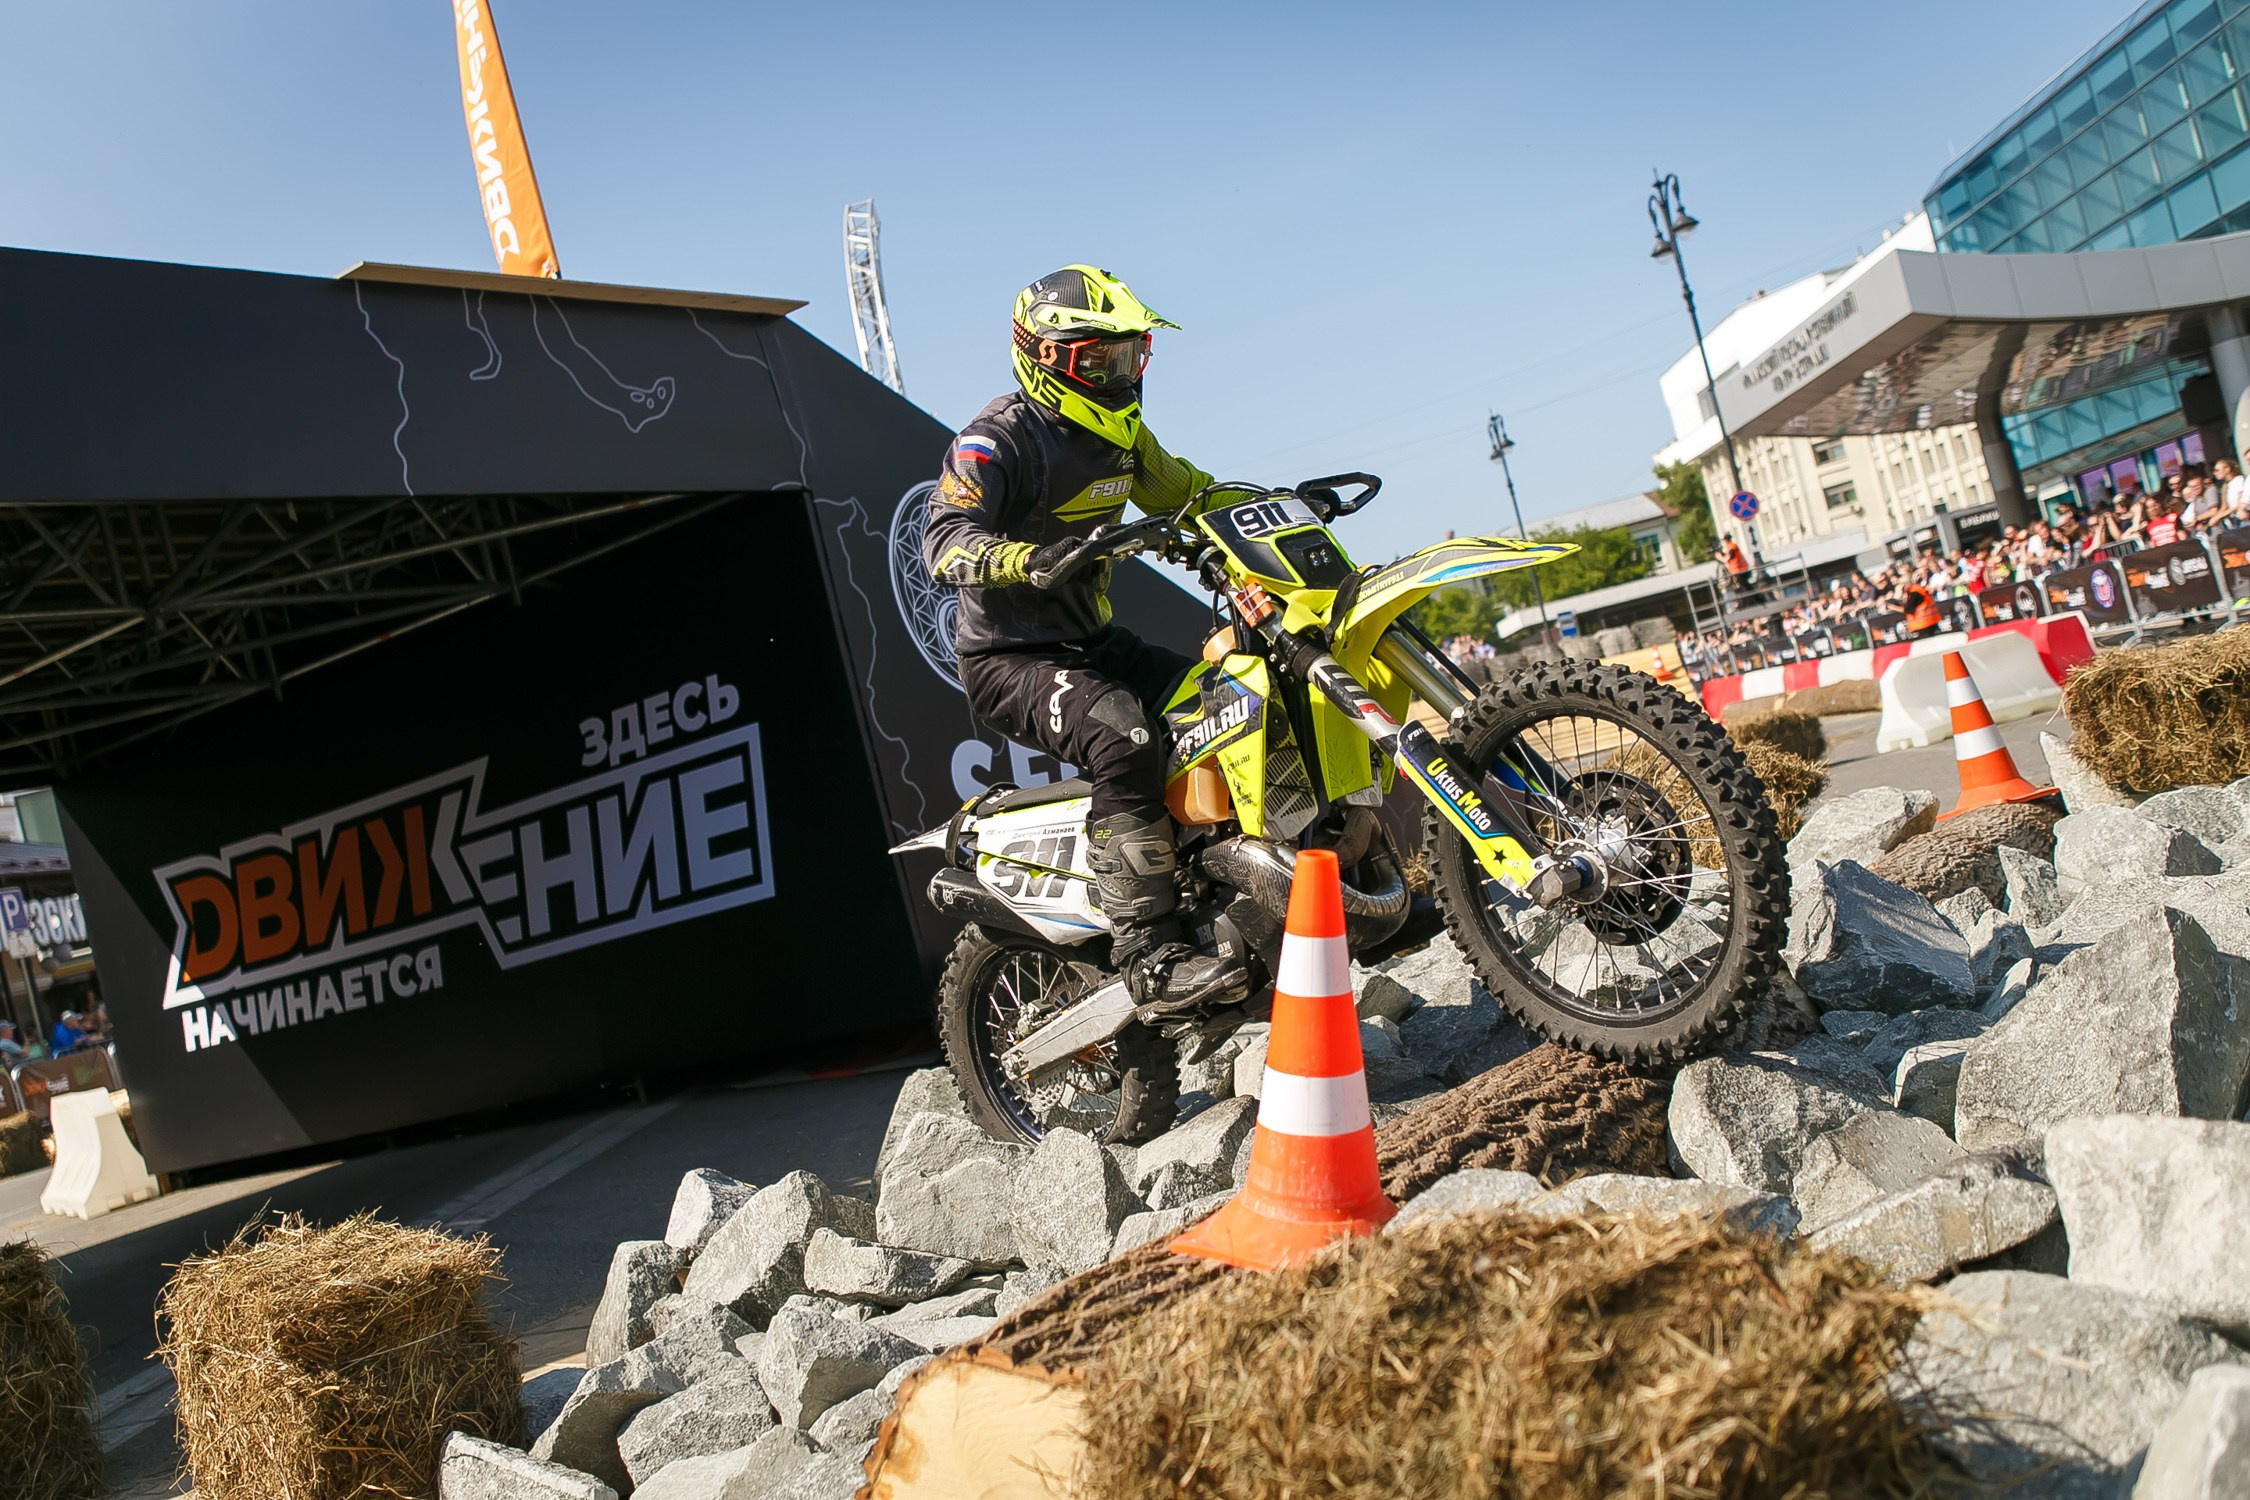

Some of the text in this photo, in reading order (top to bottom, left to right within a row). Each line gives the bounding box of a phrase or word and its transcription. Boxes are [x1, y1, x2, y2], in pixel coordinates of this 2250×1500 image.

[1233, 502, 1294, 536] 911
[578, 674, 741, 767] ЗДЕСЬ
[1094, 829, 1112, 839] 22
[991, 836, 1077, 898] 911
[181, 944, 443, 1053] НАЧИНАЕТСЯ
